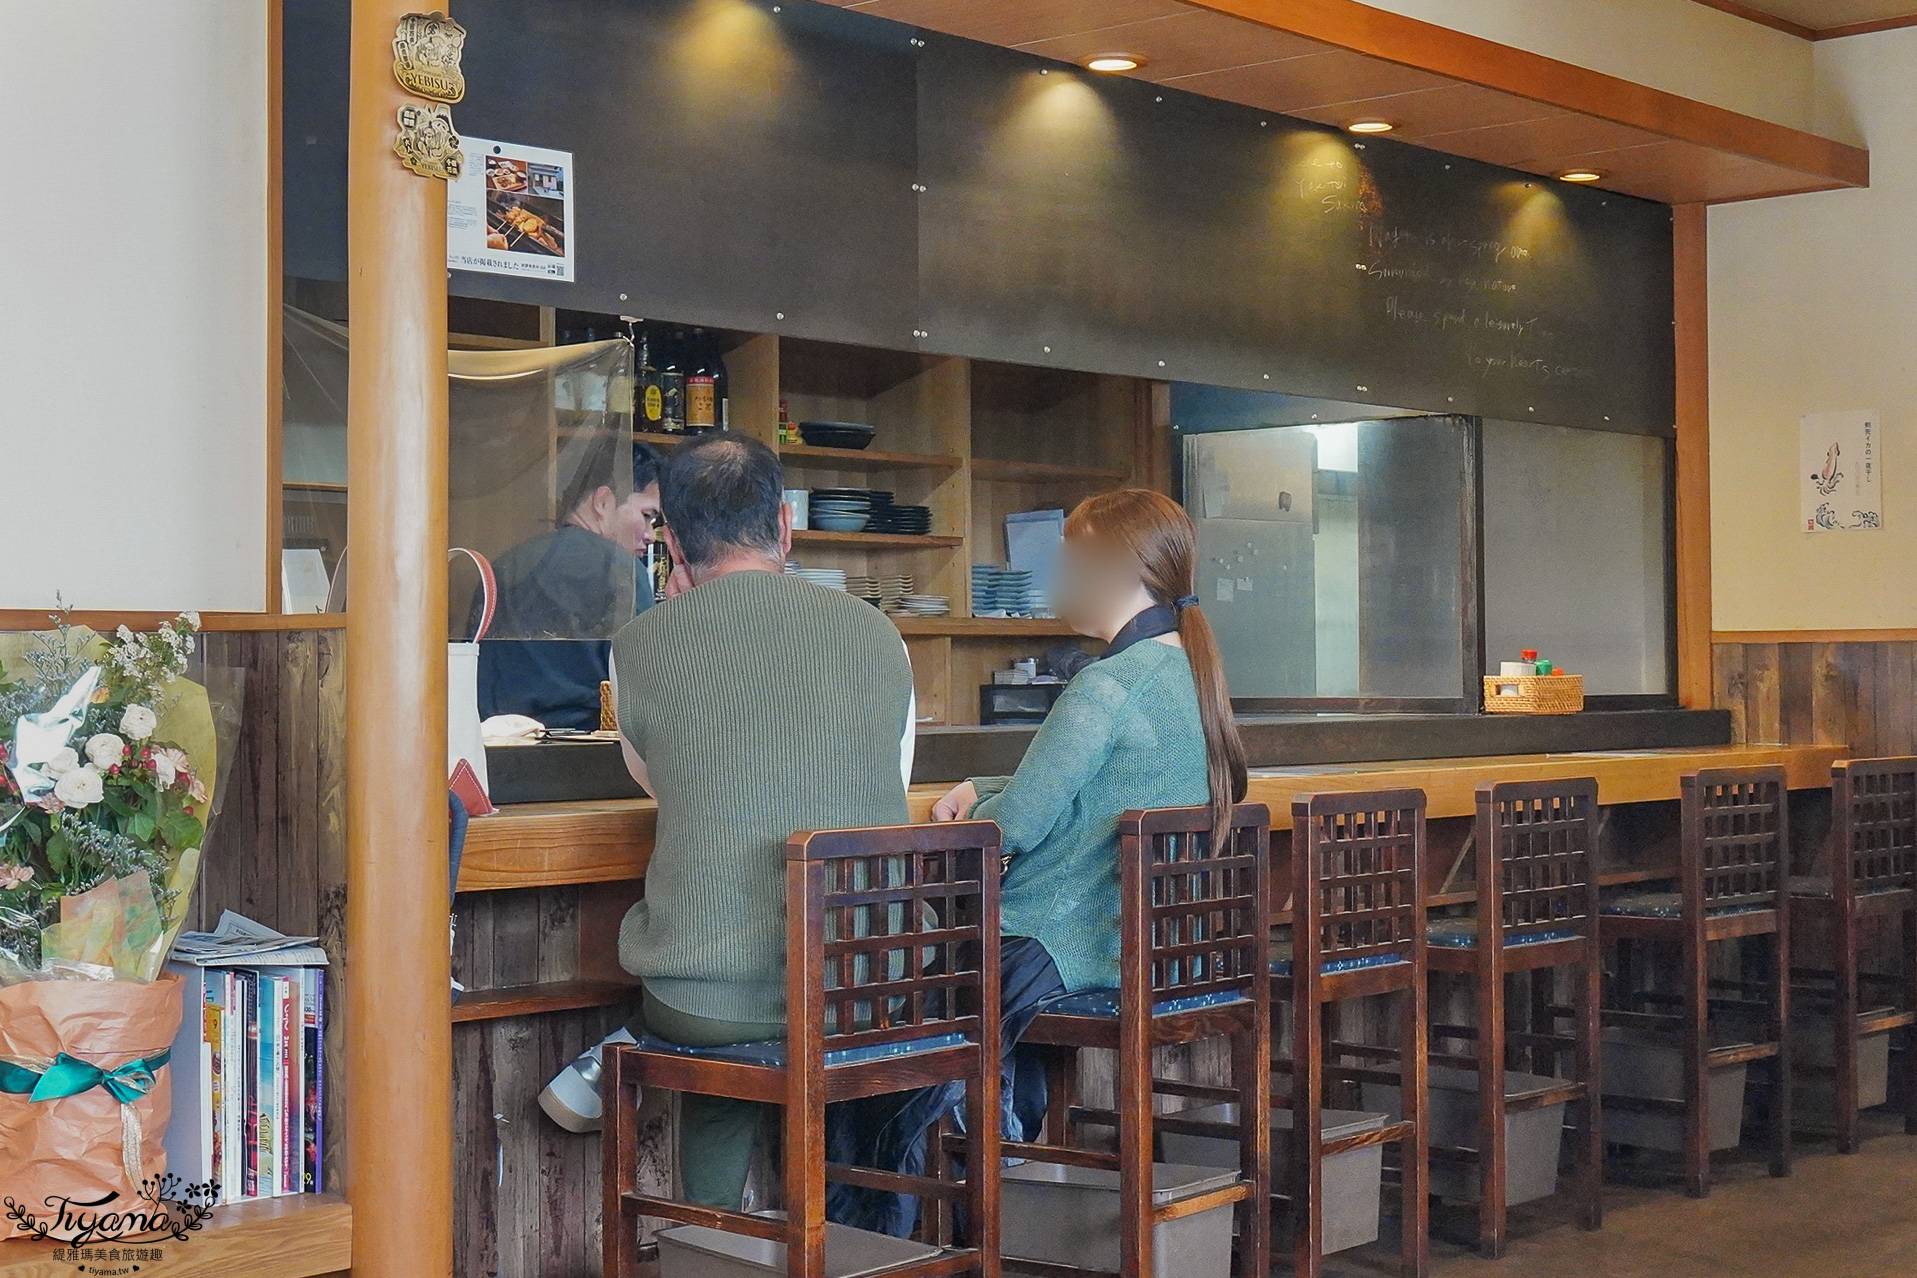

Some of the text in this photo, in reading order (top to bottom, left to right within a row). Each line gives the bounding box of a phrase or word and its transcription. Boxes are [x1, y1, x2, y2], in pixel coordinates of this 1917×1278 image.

[410, 72, 449, 91] YEBISU
[461, 256, 519, 270] 当店が掲載されました
